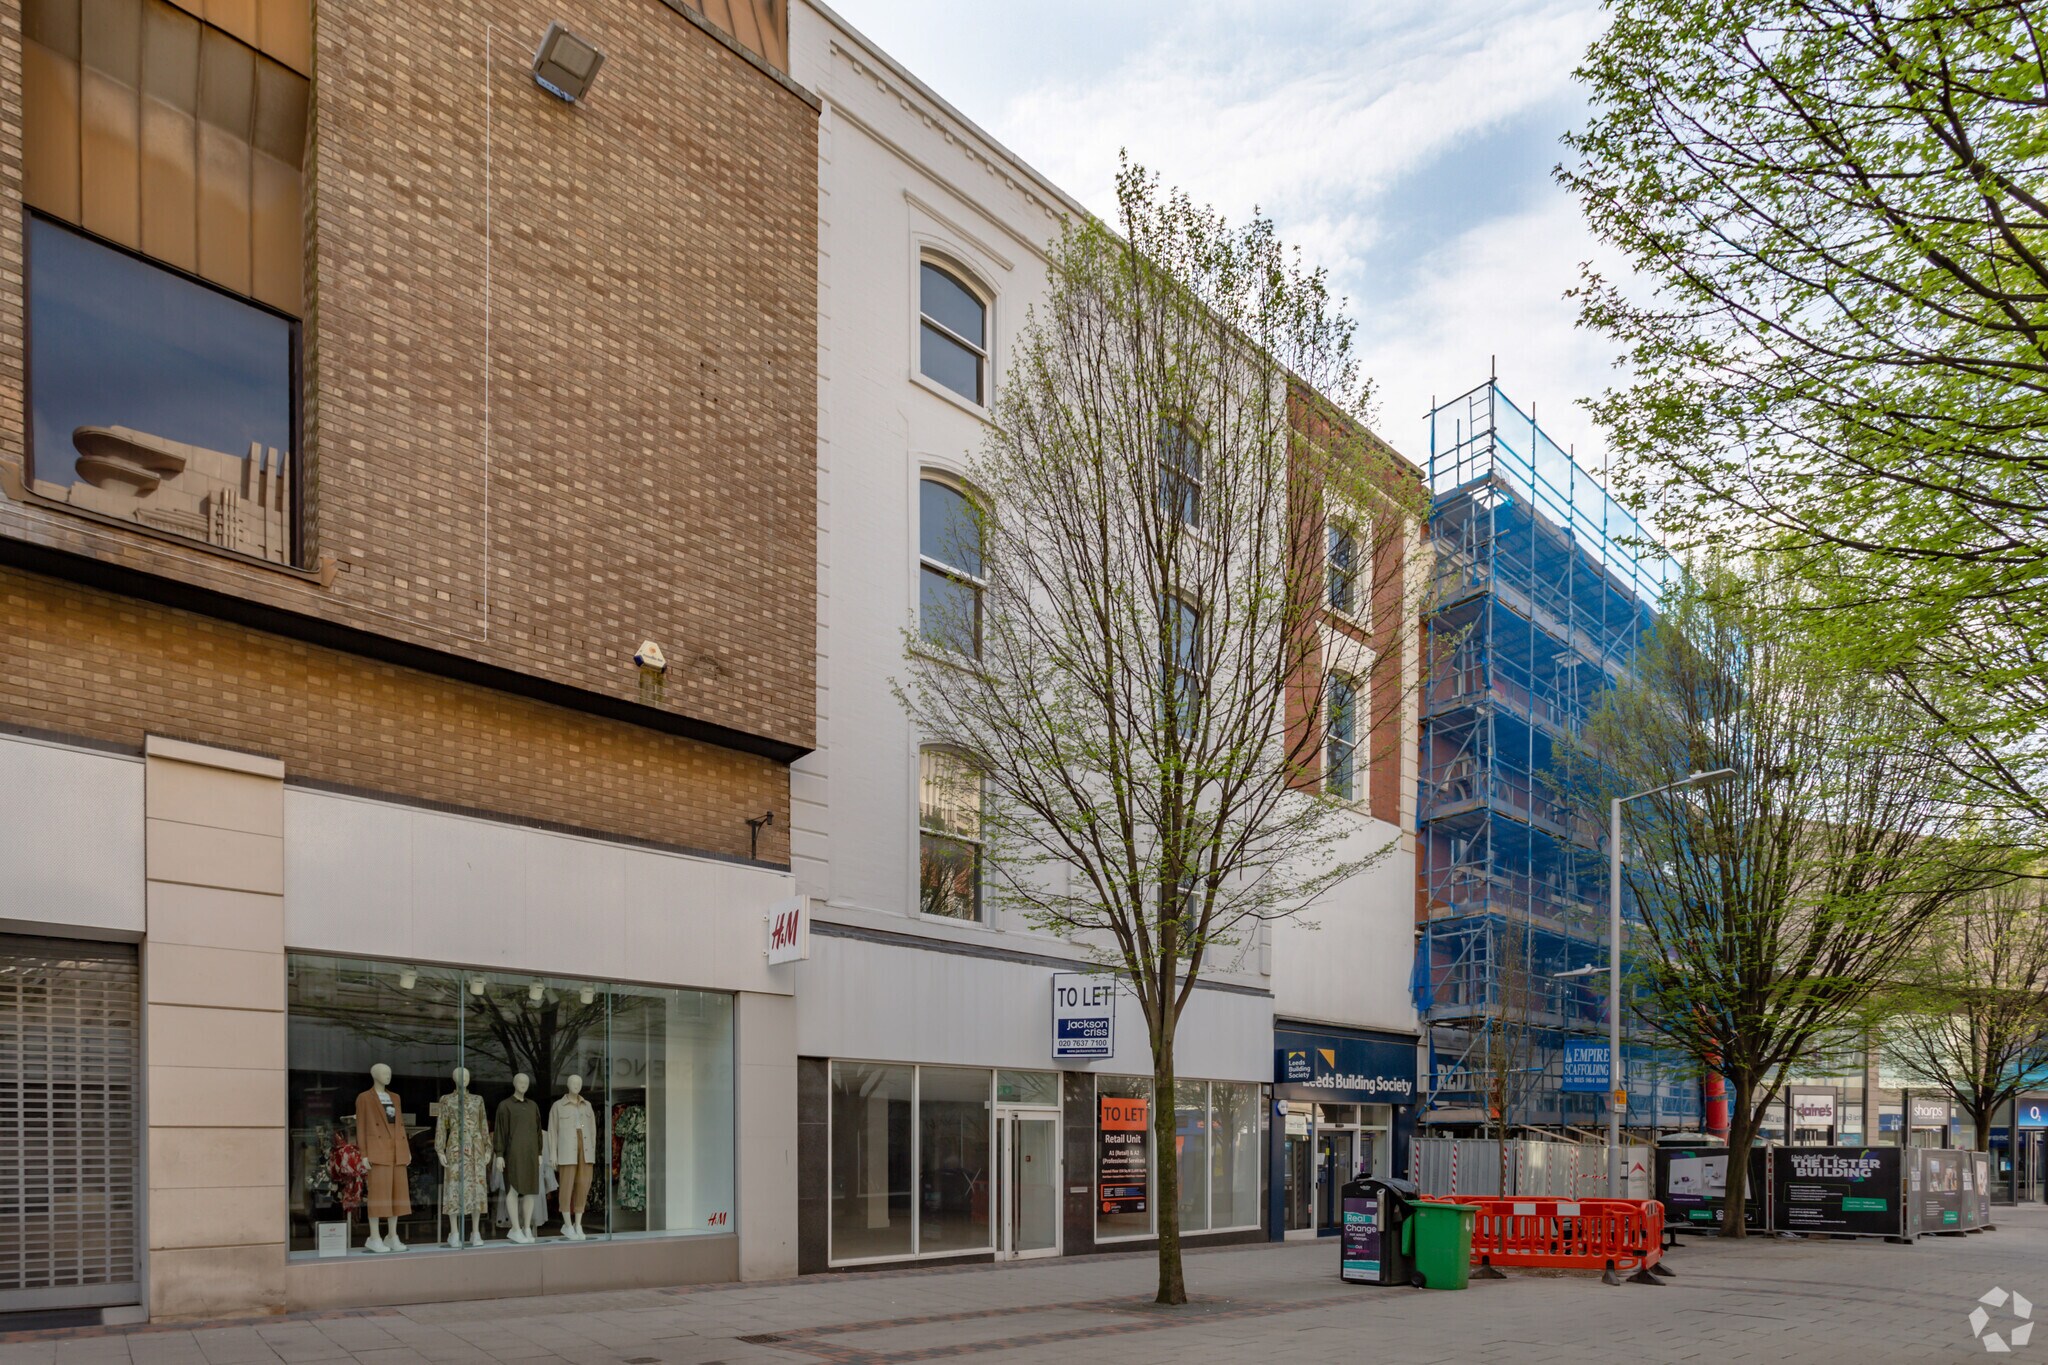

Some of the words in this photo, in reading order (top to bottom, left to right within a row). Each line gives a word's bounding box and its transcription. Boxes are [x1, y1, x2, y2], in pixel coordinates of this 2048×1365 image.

[771, 909, 799, 950] H&M
[1057, 987, 1078, 1007] TO
[1083, 986, 1111, 1006] LET
[1067, 1020, 1107, 1031] jackson
[1083, 1029, 1107, 1037] criss
[1058, 1039, 1071, 1047] 020
[1072, 1039, 1089, 1047] 7637
[1090, 1039, 1107, 1047] 7100
[1574, 1048, 1610, 1062] EMPIRE
[1564, 1063, 1609, 1076] SCAFFOLDING
[1437, 1064, 1466, 1090] RED
[1335, 1073, 1375, 1094] Building
[1376, 1076, 1412, 1096] Society
[1104, 1107, 1121, 1121] TO
[1125, 1107, 1144, 1121] LET
[1796, 1103, 1832, 1117] claire's
[1914, 1104, 1943, 1119] sharps
[1105, 1134, 1125, 1143] Retail
[1126, 1134, 1141, 1143] Unit
[1791, 1159, 1821, 1168] THE
[1823, 1159, 1881, 1169] LISTER
[1796, 1168, 1872, 1178] BUILDING
[708, 1211, 727, 1226] H&M
[1347, 1214, 1366, 1222] Real
[1346, 1224, 1377, 1234] Change
